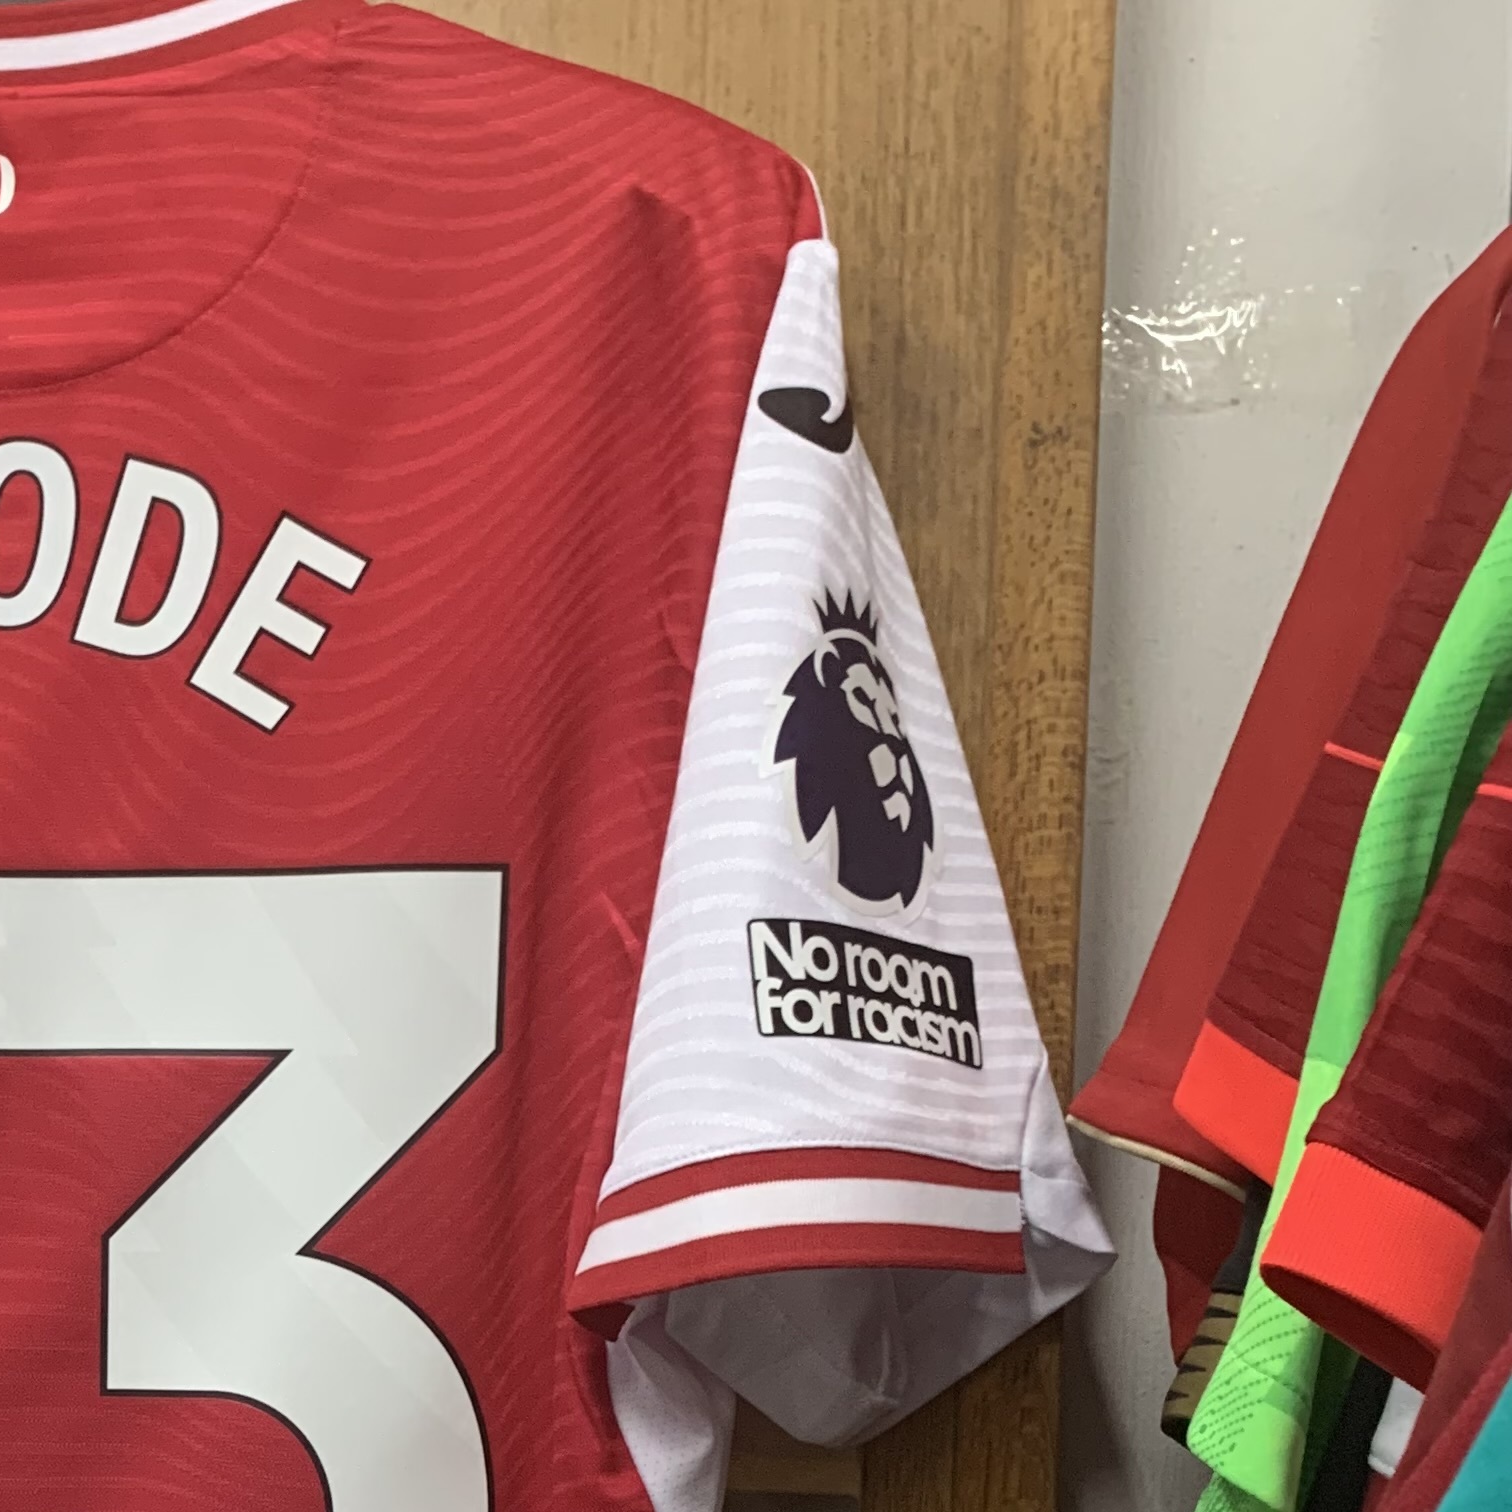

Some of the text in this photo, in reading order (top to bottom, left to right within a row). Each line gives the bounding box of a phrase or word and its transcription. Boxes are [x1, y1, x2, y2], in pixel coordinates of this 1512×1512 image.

[750, 921, 958, 1010] No room
[848, 993, 981, 1067] racism
